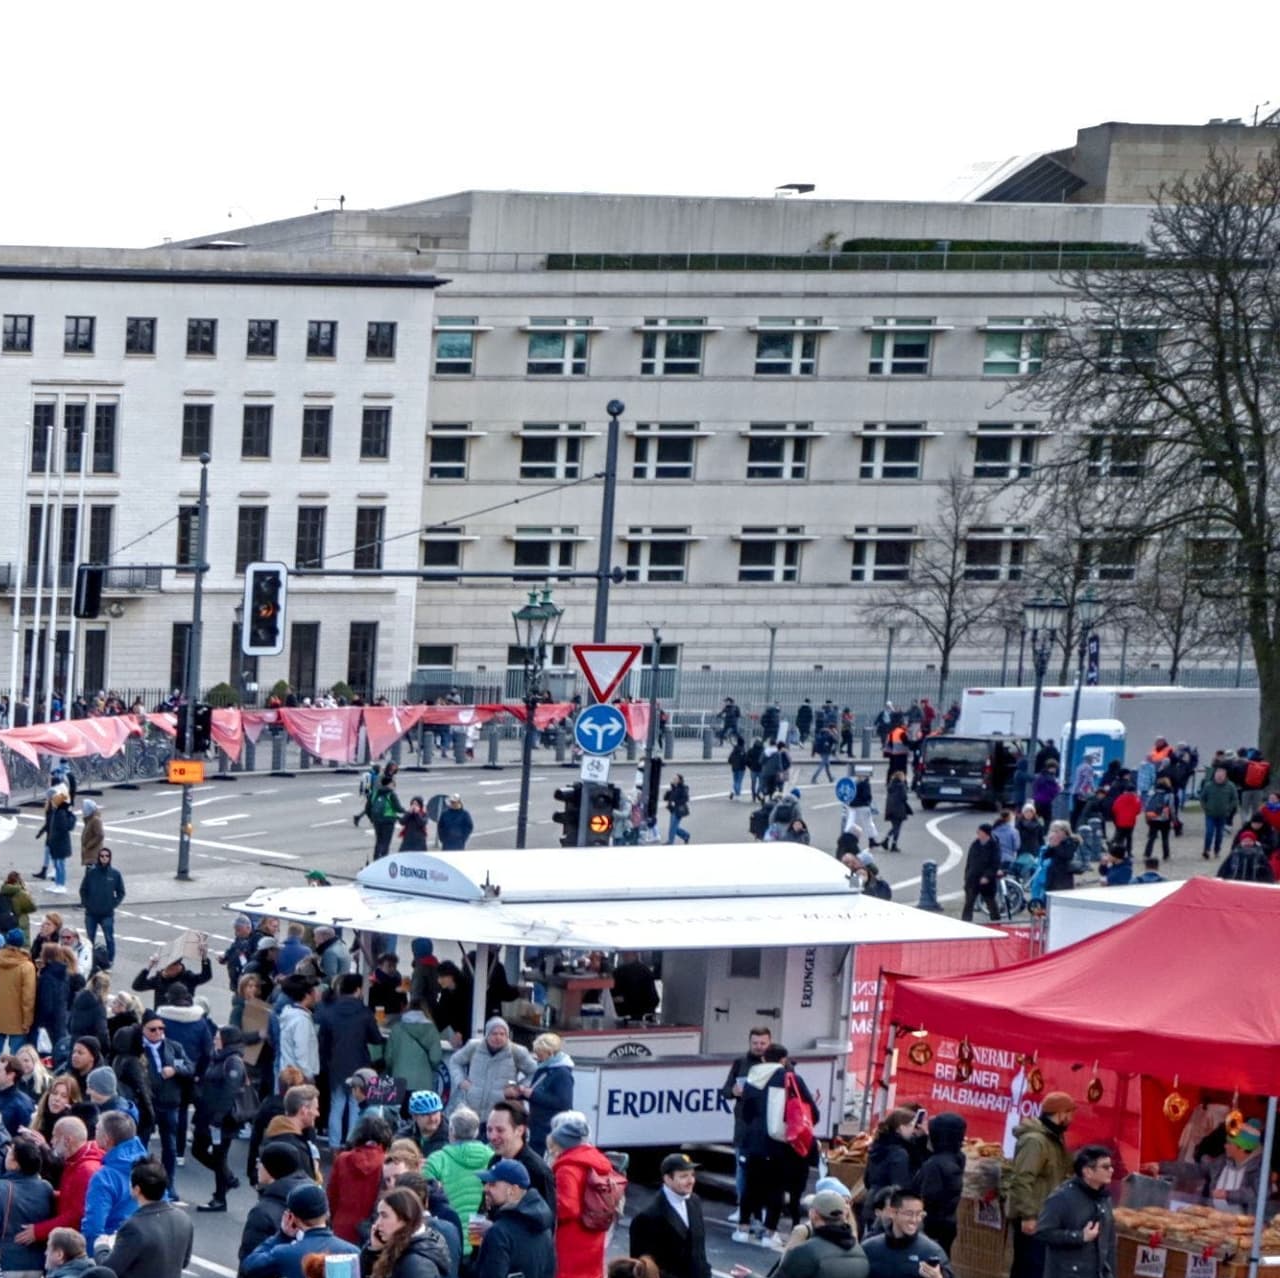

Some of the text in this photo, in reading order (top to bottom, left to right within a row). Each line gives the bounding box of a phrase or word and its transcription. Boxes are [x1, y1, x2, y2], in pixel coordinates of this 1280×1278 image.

[399, 865, 428, 880] ERDINGER
[800, 947, 817, 1008] ERDINGER
[606, 1089, 734, 1118] ERDINGER
